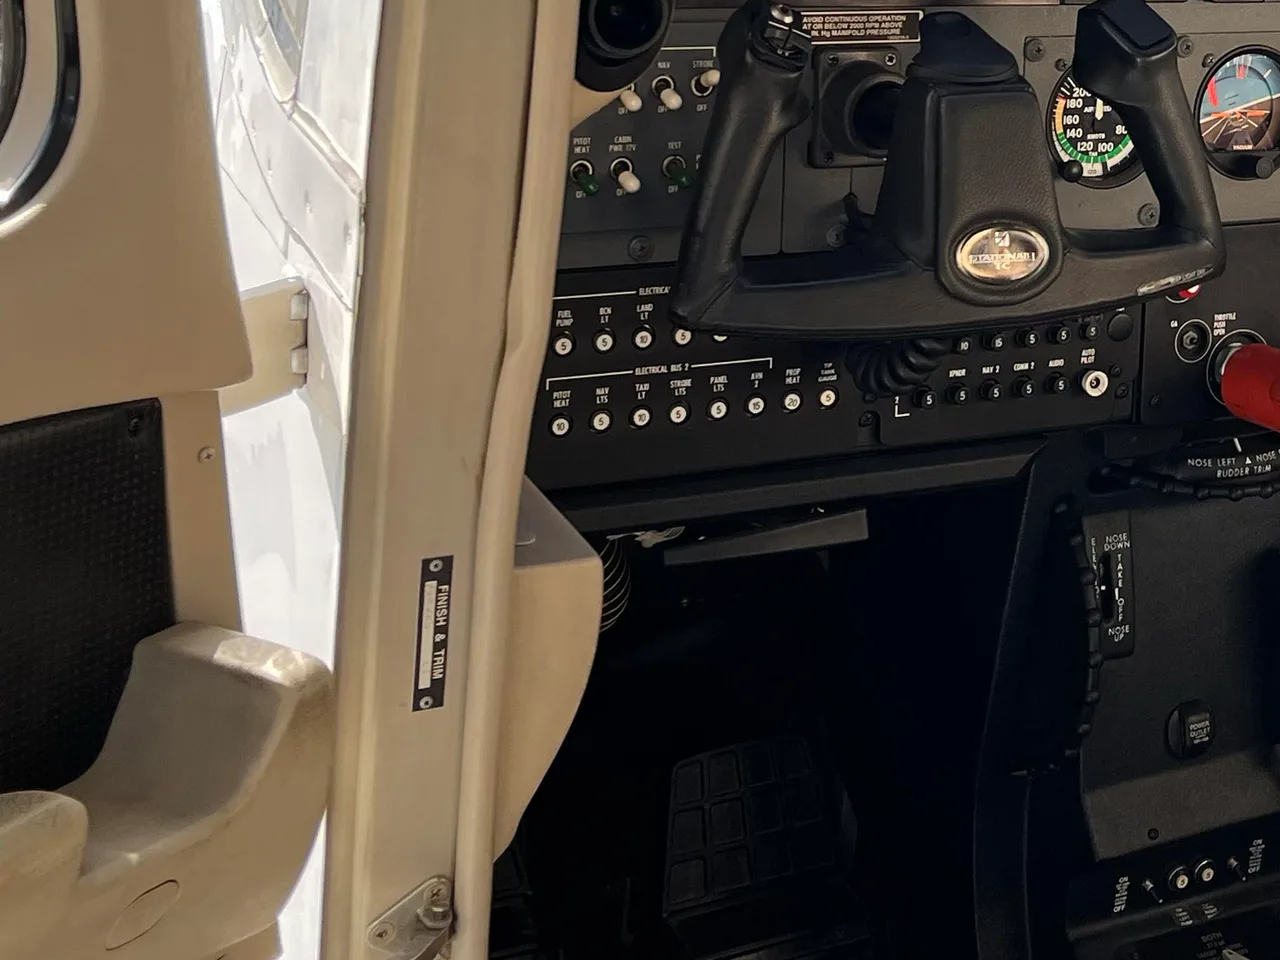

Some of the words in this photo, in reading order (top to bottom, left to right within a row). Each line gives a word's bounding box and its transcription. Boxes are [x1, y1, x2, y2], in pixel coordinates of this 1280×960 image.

[824, 22, 849, 30] BELOW
[658, 61, 671, 69] NAV
[696, 104, 707, 112] OFF
[1066, 99, 1083, 109] 180
[1063, 115, 1080, 125] 160
[1066, 128, 1083, 138] 140
[574, 145, 590, 153] HEAT
[1077, 141, 1094, 151] 120
[1098, 142, 1114, 152] 100
[636, 303, 653, 312] LAND
[557, 310, 572, 318] FUEL
[641, 312, 649, 320] LT
[556, 318, 573, 327] PUMP
[640, 335, 648, 344] 10
[1030, 334, 1035, 343] 5
[1061, 331, 1067, 340] 5
[561, 342, 567, 350] 5
[602, 338, 607, 347] 5
[960, 342, 968, 350] 10
[995, 338, 1002, 347] 15
[1049, 359, 1064, 367] AUDIO
[635, 365, 668, 375] ELECTRICAL
[671, 364, 682, 372] BUS
[785, 368, 801, 376] PROP
[982, 366, 993, 374] NAV
[670, 379, 692, 388] STROBE
[710, 375, 728, 384] PANEL
[785, 376, 800, 384] HEAT
[713, 384, 725, 392] LTS
[1027, 385, 1032, 394] 5
[1059, 381, 1064, 390] 5
[553, 390, 571, 399] PITOT
[595, 387, 610, 395] NAV
[638, 391, 646, 400] LT
[675, 387, 686, 396] LTS
[960, 391, 965, 400] 5
[993, 388, 999, 397] 5
[553, 399, 570, 408] HEAT
[596, 395, 608, 404] LTS
[787, 398, 798, 407] 20
[927, 395, 932, 404] 5
[753, 402, 760, 410] 15
[638, 413, 647, 422] 10
[676, 410, 682, 419] 5
[599, 417, 604, 425] 5
[556, 422, 565, 431] 10
[1256, 450, 1276, 461] NOSE
[1187, 458, 1212, 467] NOSE
[1217, 458, 1236, 467] LEFT
[1217, 467, 1250, 478] RUDDER
[1253, 464, 1272, 474] TRIM
[1105, 533, 1128, 543] NOSE
[1104, 542, 1130, 551] DOWN
[435, 584, 449, 626] FINISH
[1108, 625, 1130, 636] NOSE
[434, 634, 446, 643] &
[1114, 633, 1124, 642] UP
[432, 649, 445, 680] TRIM
[1189, 721, 1210, 730] POWER
[1190, 727, 1211, 737] OUTLET
[1248, 865, 1261, 874] OFF
[1113, 904, 1126, 913] OFF
